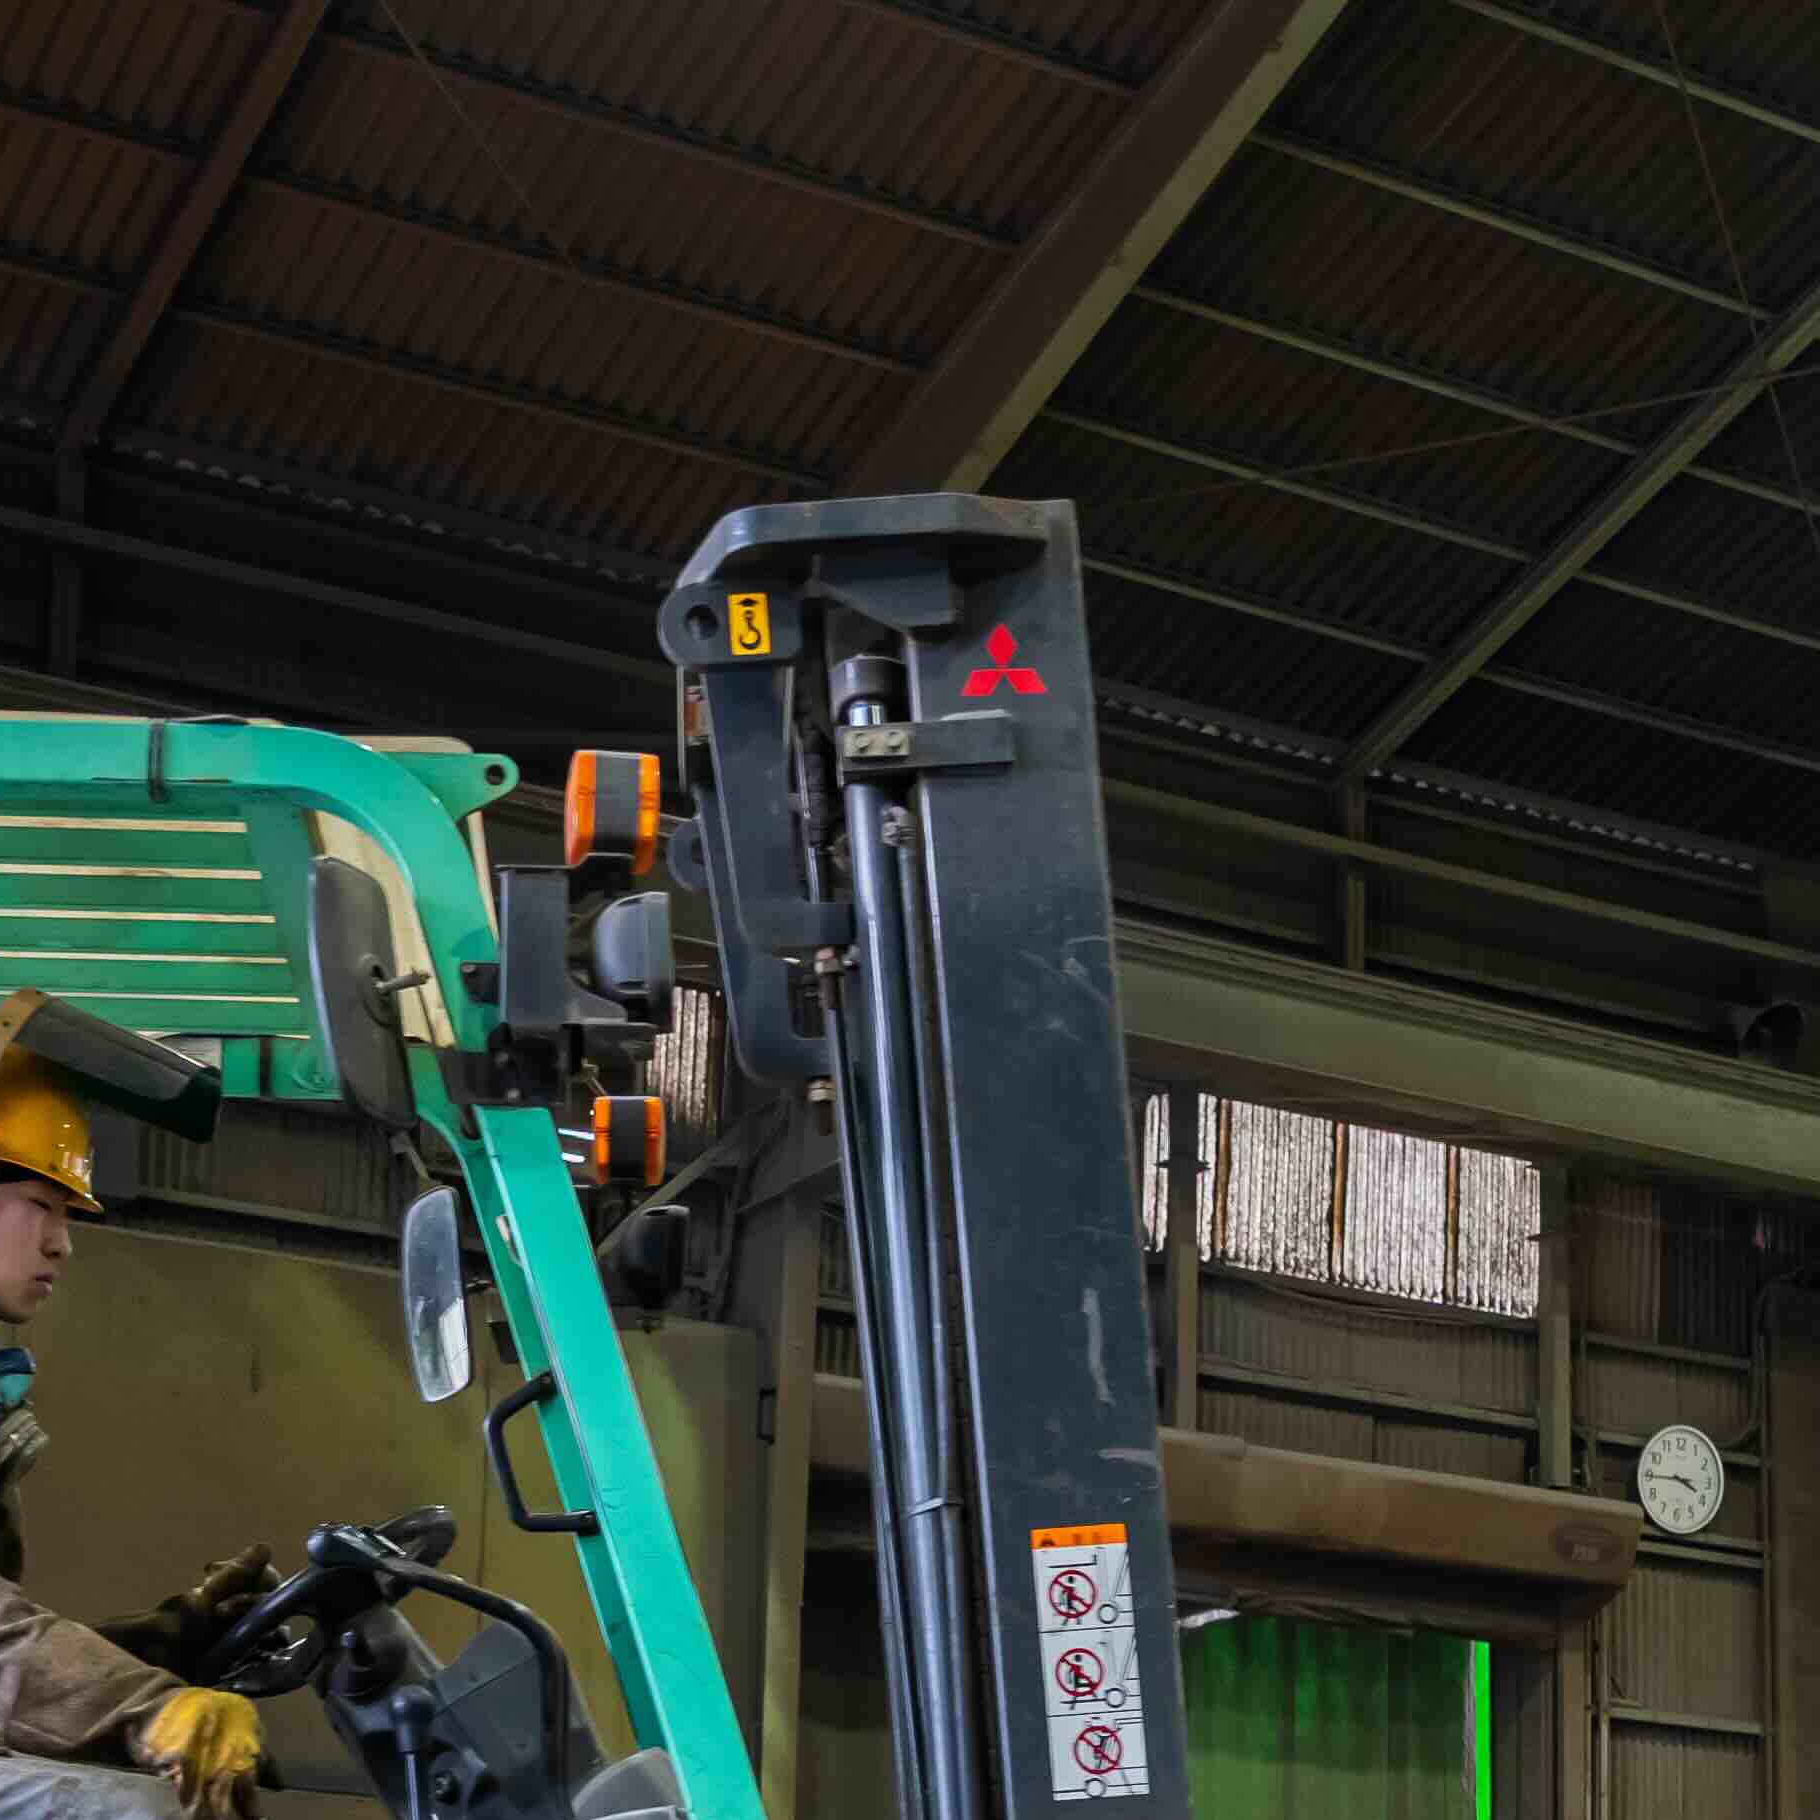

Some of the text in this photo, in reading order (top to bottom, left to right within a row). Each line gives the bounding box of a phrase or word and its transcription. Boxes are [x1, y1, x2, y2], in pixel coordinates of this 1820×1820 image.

[1662, 1439, 1671, 1453] 11
[1676, 1438, 1686, 1451] 12
[1651, 1452, 1661, 1466] 10
